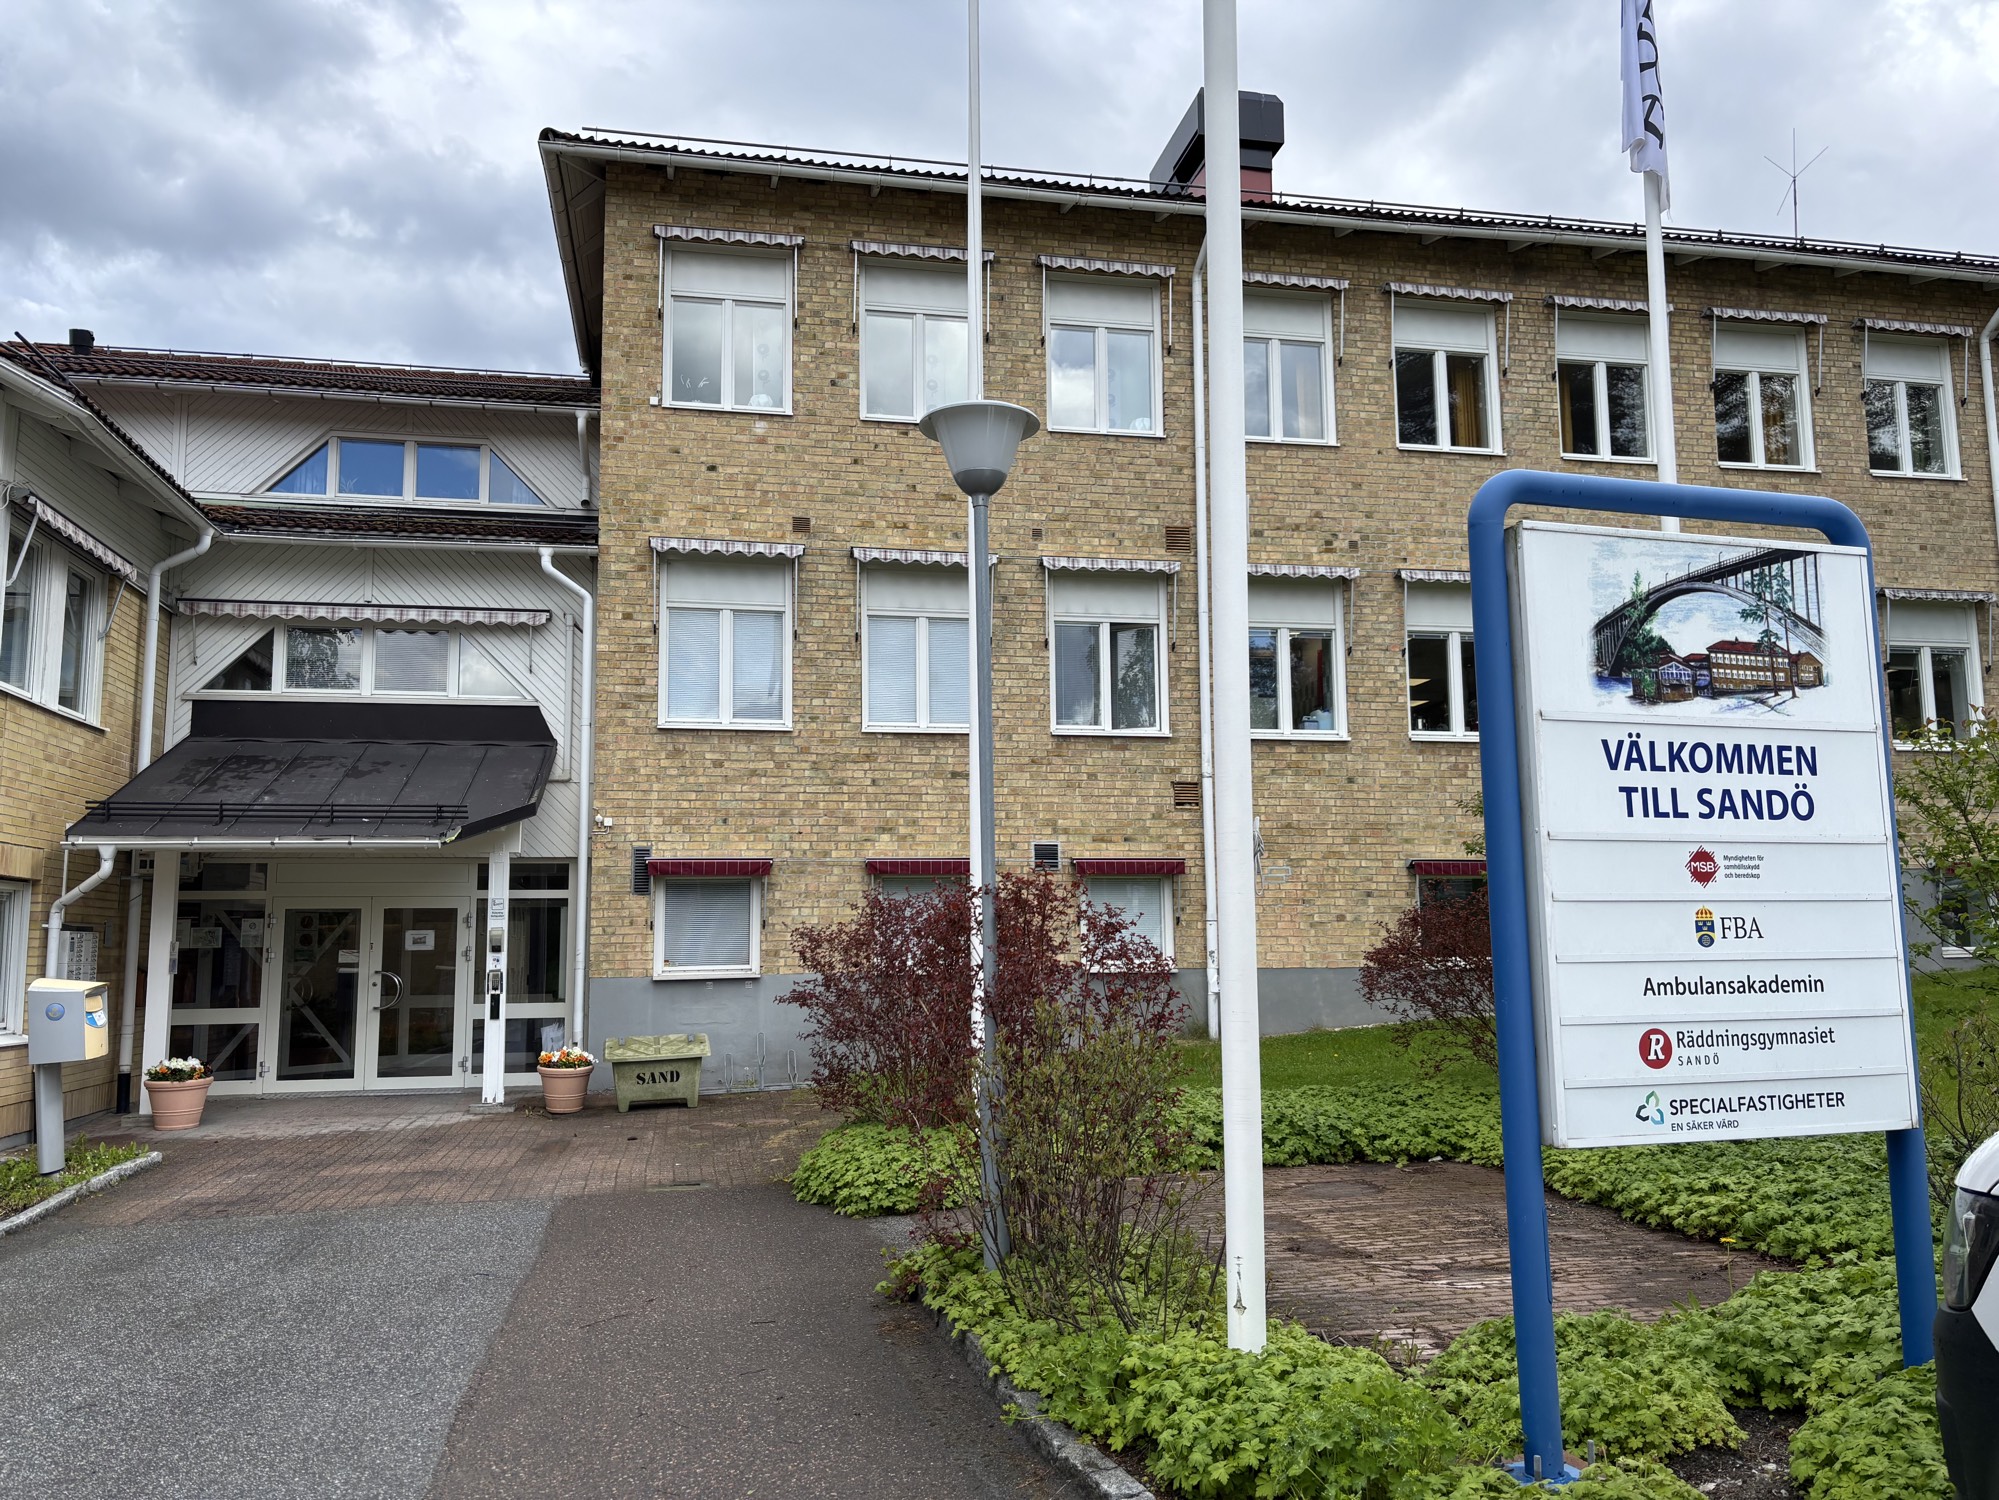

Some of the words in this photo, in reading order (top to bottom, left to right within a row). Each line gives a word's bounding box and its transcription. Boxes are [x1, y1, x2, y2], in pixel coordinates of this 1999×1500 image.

[1601, 732, 1818, 776] VÄLKOMMEN
[1619, 786, 1689, 819] TILL
[1697, 783, 1815, 821] SANDÖ
[1690, 861, 1715, 873] MSB
[1723, 854, 1756, 863] Myndigheten
[1724, 863, 1760, 871] samhällsskydd
[1734, 872, 1760, 880] beredskap
[1720, 916, 1764, 939] FBA
[1643, 974, 1825, 996] Ambulansakademin
[1648, 1035, 1665, 1060] R
[1676, 1026, 1836, 1051] Räddningsgymnasiet
[1678, 1053, 1720, 1066] SANDÖ
[636, 1070, 681, 1086] SAND
[1669, 1092, 1846, 1116] SPECIALFASTIGHETER
[1671, 1122, 1684, 1132] EN
[1686, 1121, 1714, 1131] SÄKER
[1716, 1119, 1739, 1129] VÄRD
